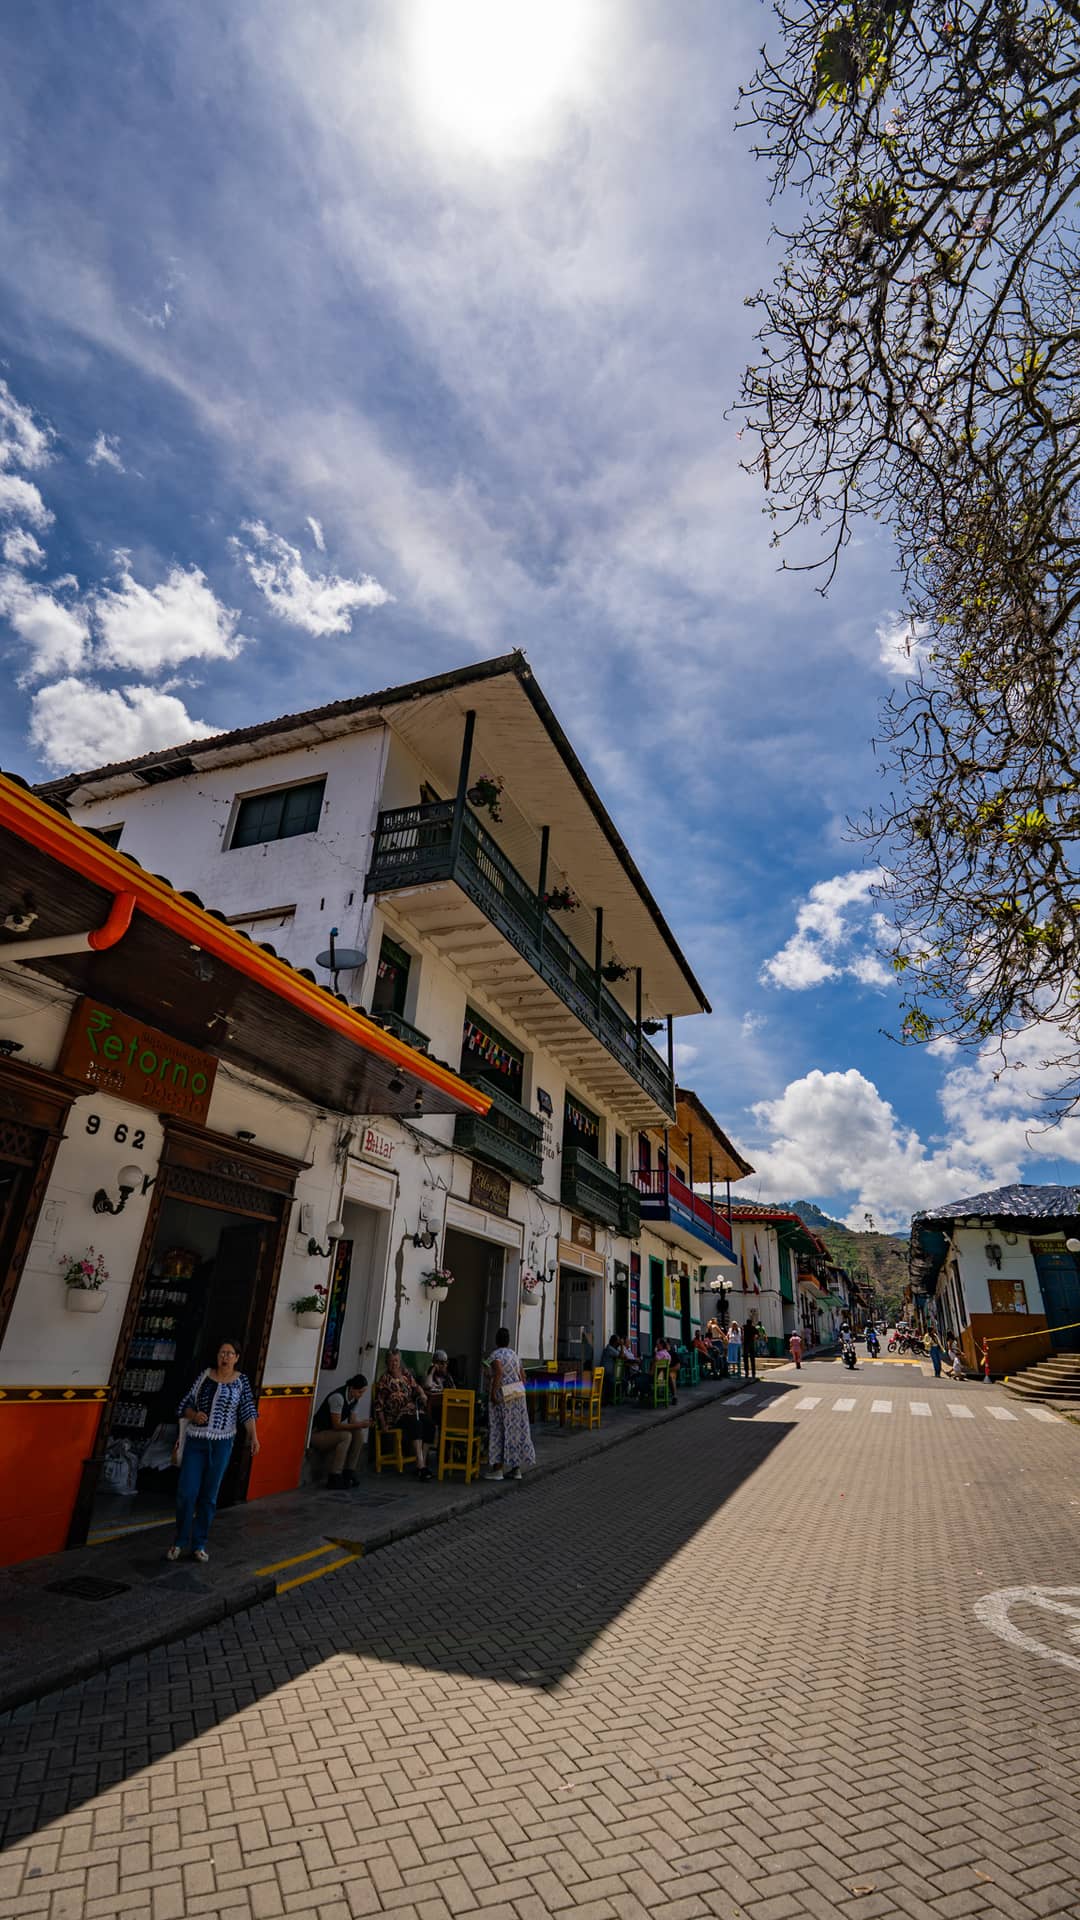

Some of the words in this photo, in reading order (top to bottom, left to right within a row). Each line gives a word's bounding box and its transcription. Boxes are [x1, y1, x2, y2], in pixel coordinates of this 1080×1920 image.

[86, 1009, 208, 1095] Retorno
[85, 1114, 101, 1135] 9
[114, 1124, 146, 1150] 62
